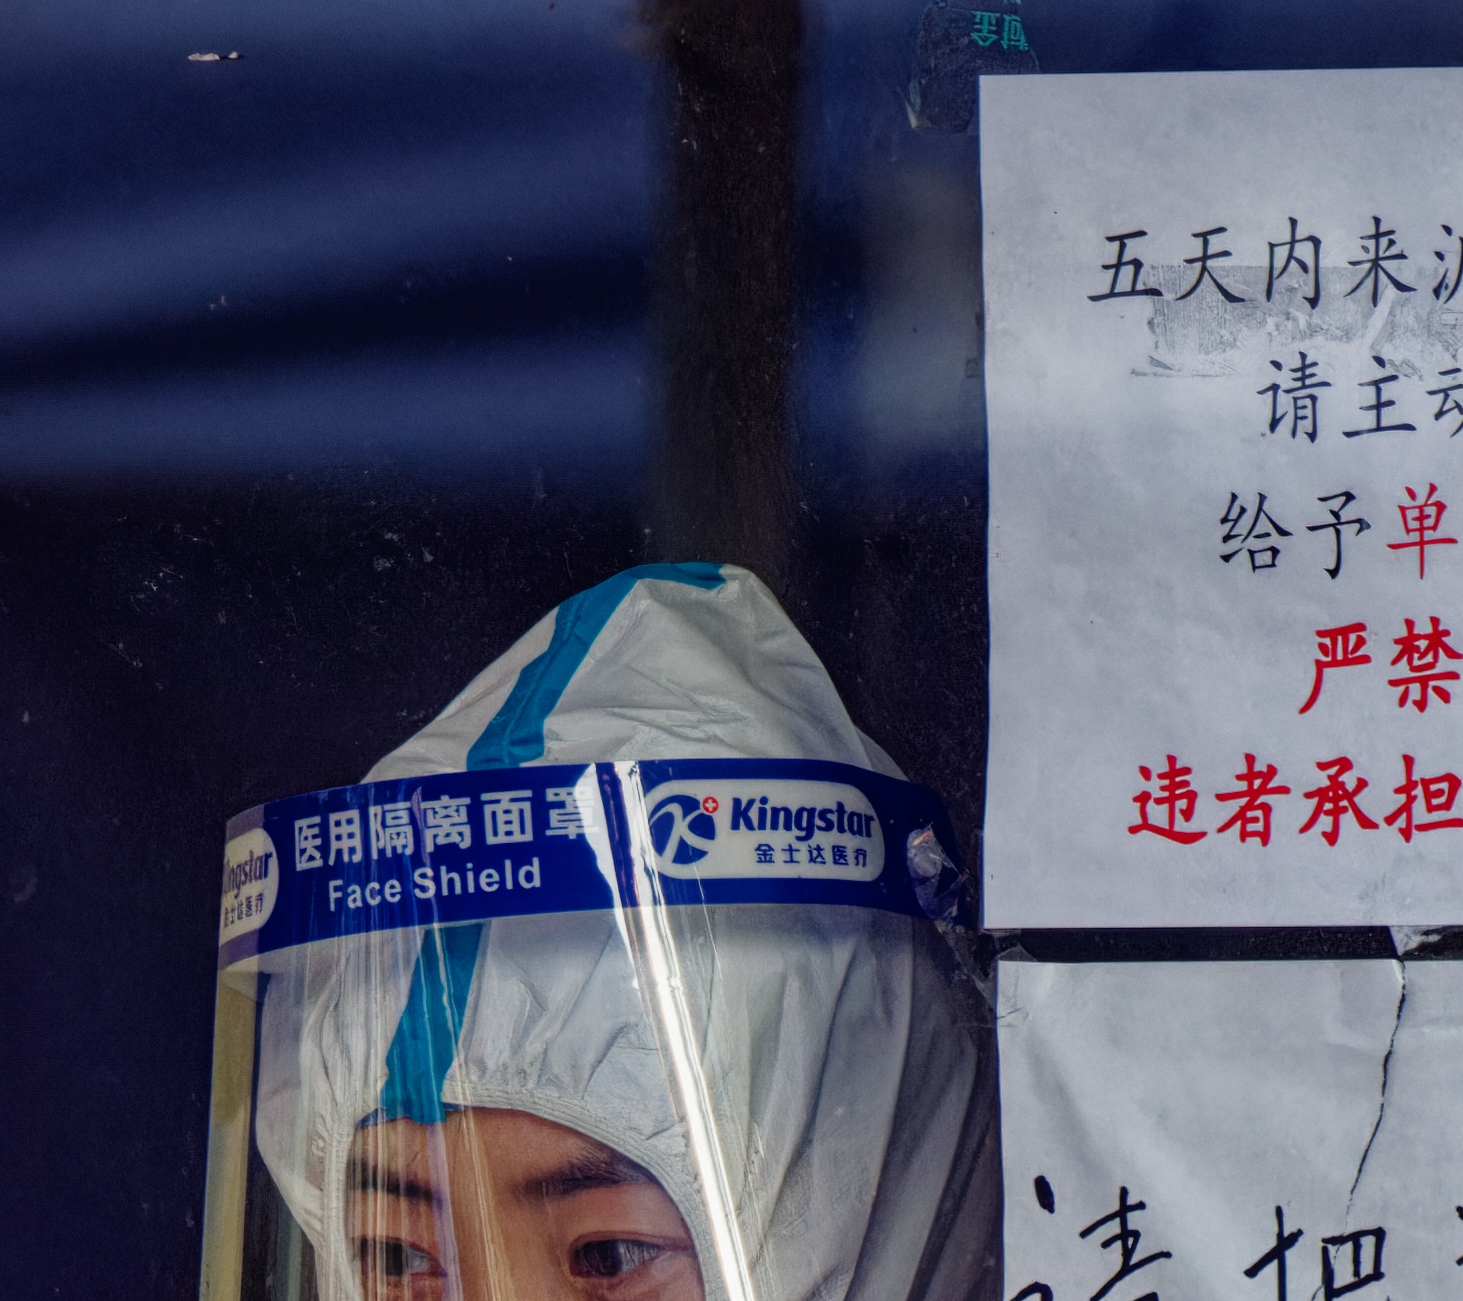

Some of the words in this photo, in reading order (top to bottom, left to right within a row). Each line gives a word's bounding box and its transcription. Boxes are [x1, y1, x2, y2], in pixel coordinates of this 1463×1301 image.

[294, 786, 600, 871] 医用隔离面罩
[730, 796, 875, 842] Kingstar
[755, 843, 868, 868] 金士达医疗
[328, 878, 402, 912] Face
[413, 857, 541, 900] Shield
